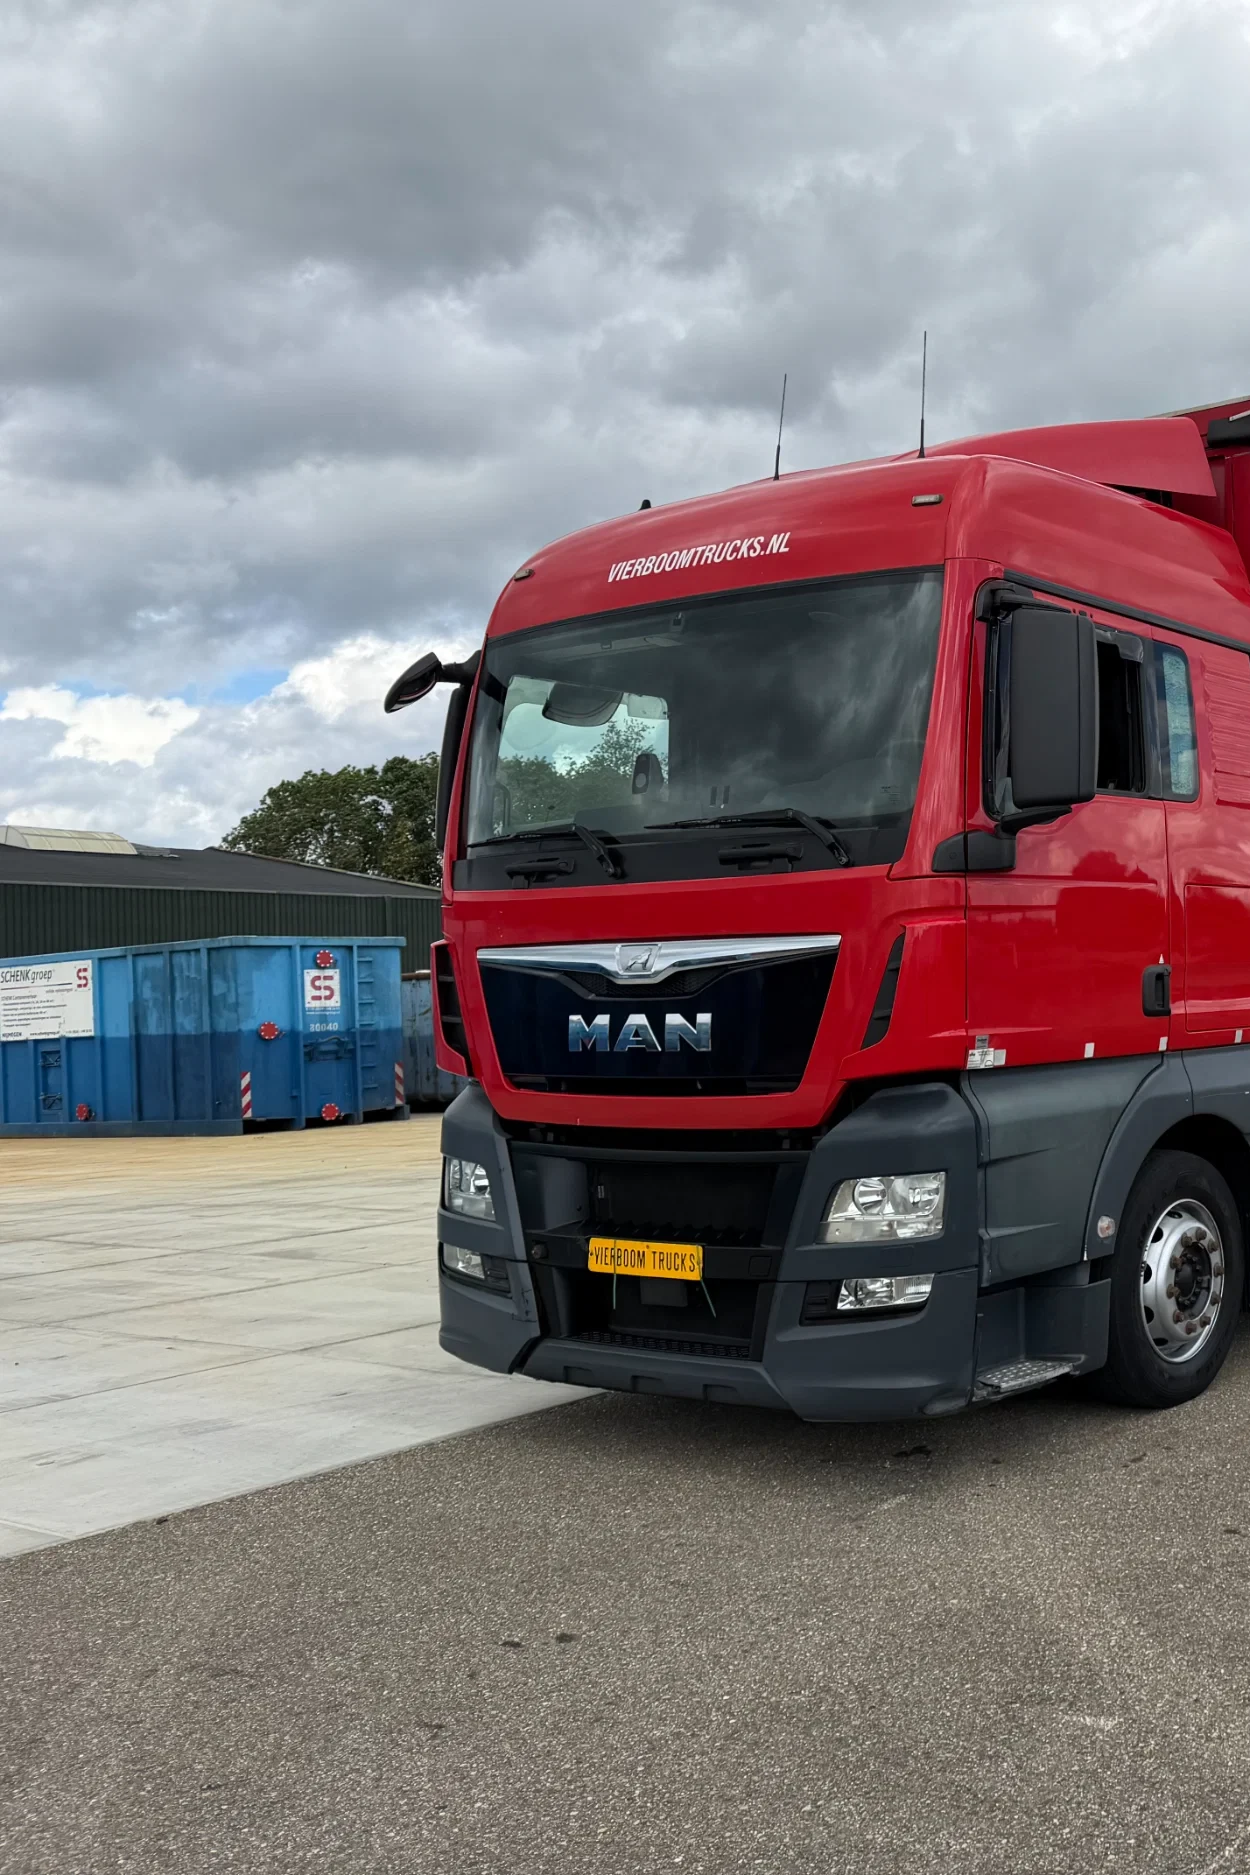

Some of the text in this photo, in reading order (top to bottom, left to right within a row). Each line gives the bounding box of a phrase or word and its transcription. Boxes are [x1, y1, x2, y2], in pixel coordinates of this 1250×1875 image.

[607, 532, 791, 583] VIERBOOMTRUCKS.NL
[568, 1013, 712, 1052] MAN
[594, 1246, 696, 1273] VIERBOOM TRUCKS
